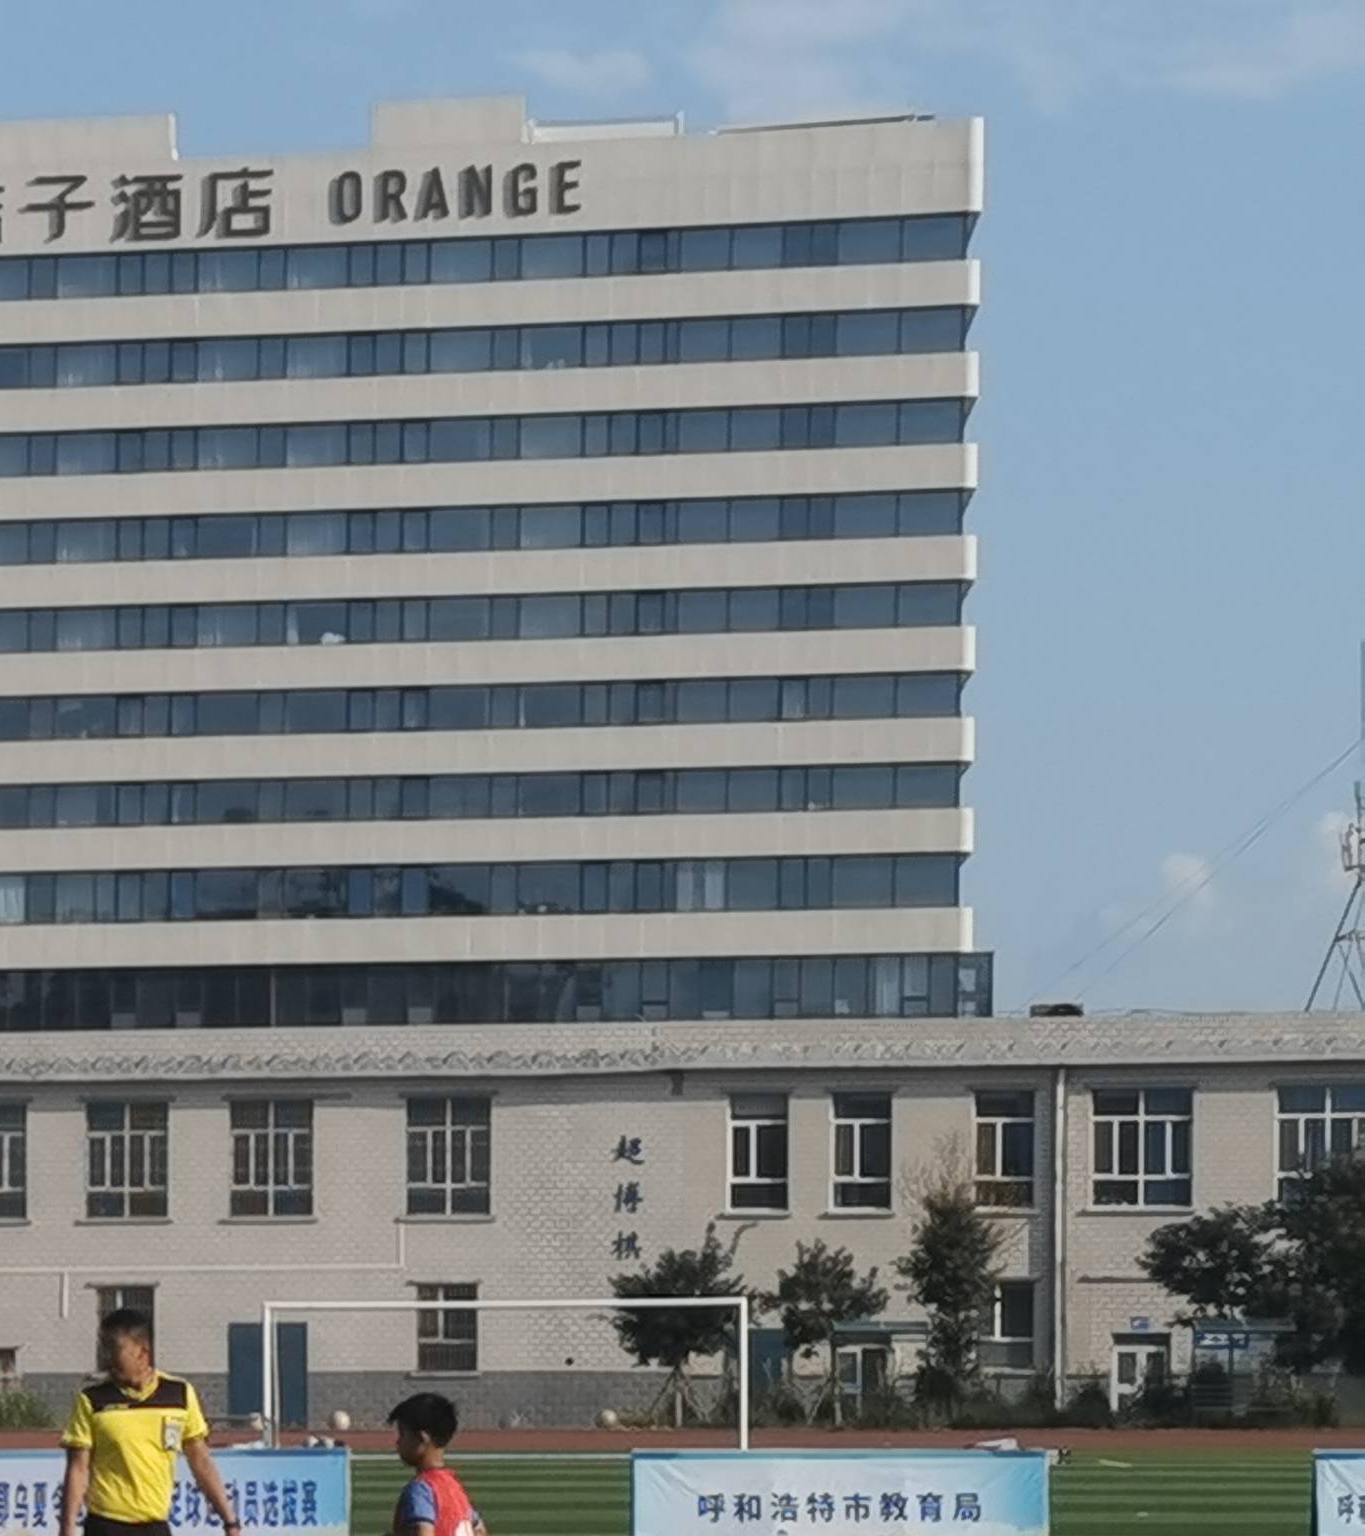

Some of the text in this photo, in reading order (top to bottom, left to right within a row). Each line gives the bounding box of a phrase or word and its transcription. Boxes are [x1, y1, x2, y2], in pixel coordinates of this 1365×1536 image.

[327, 159, 582, 226] ORANGE
[697, 1492, 983, 1523] 呼和浩特市教育局
